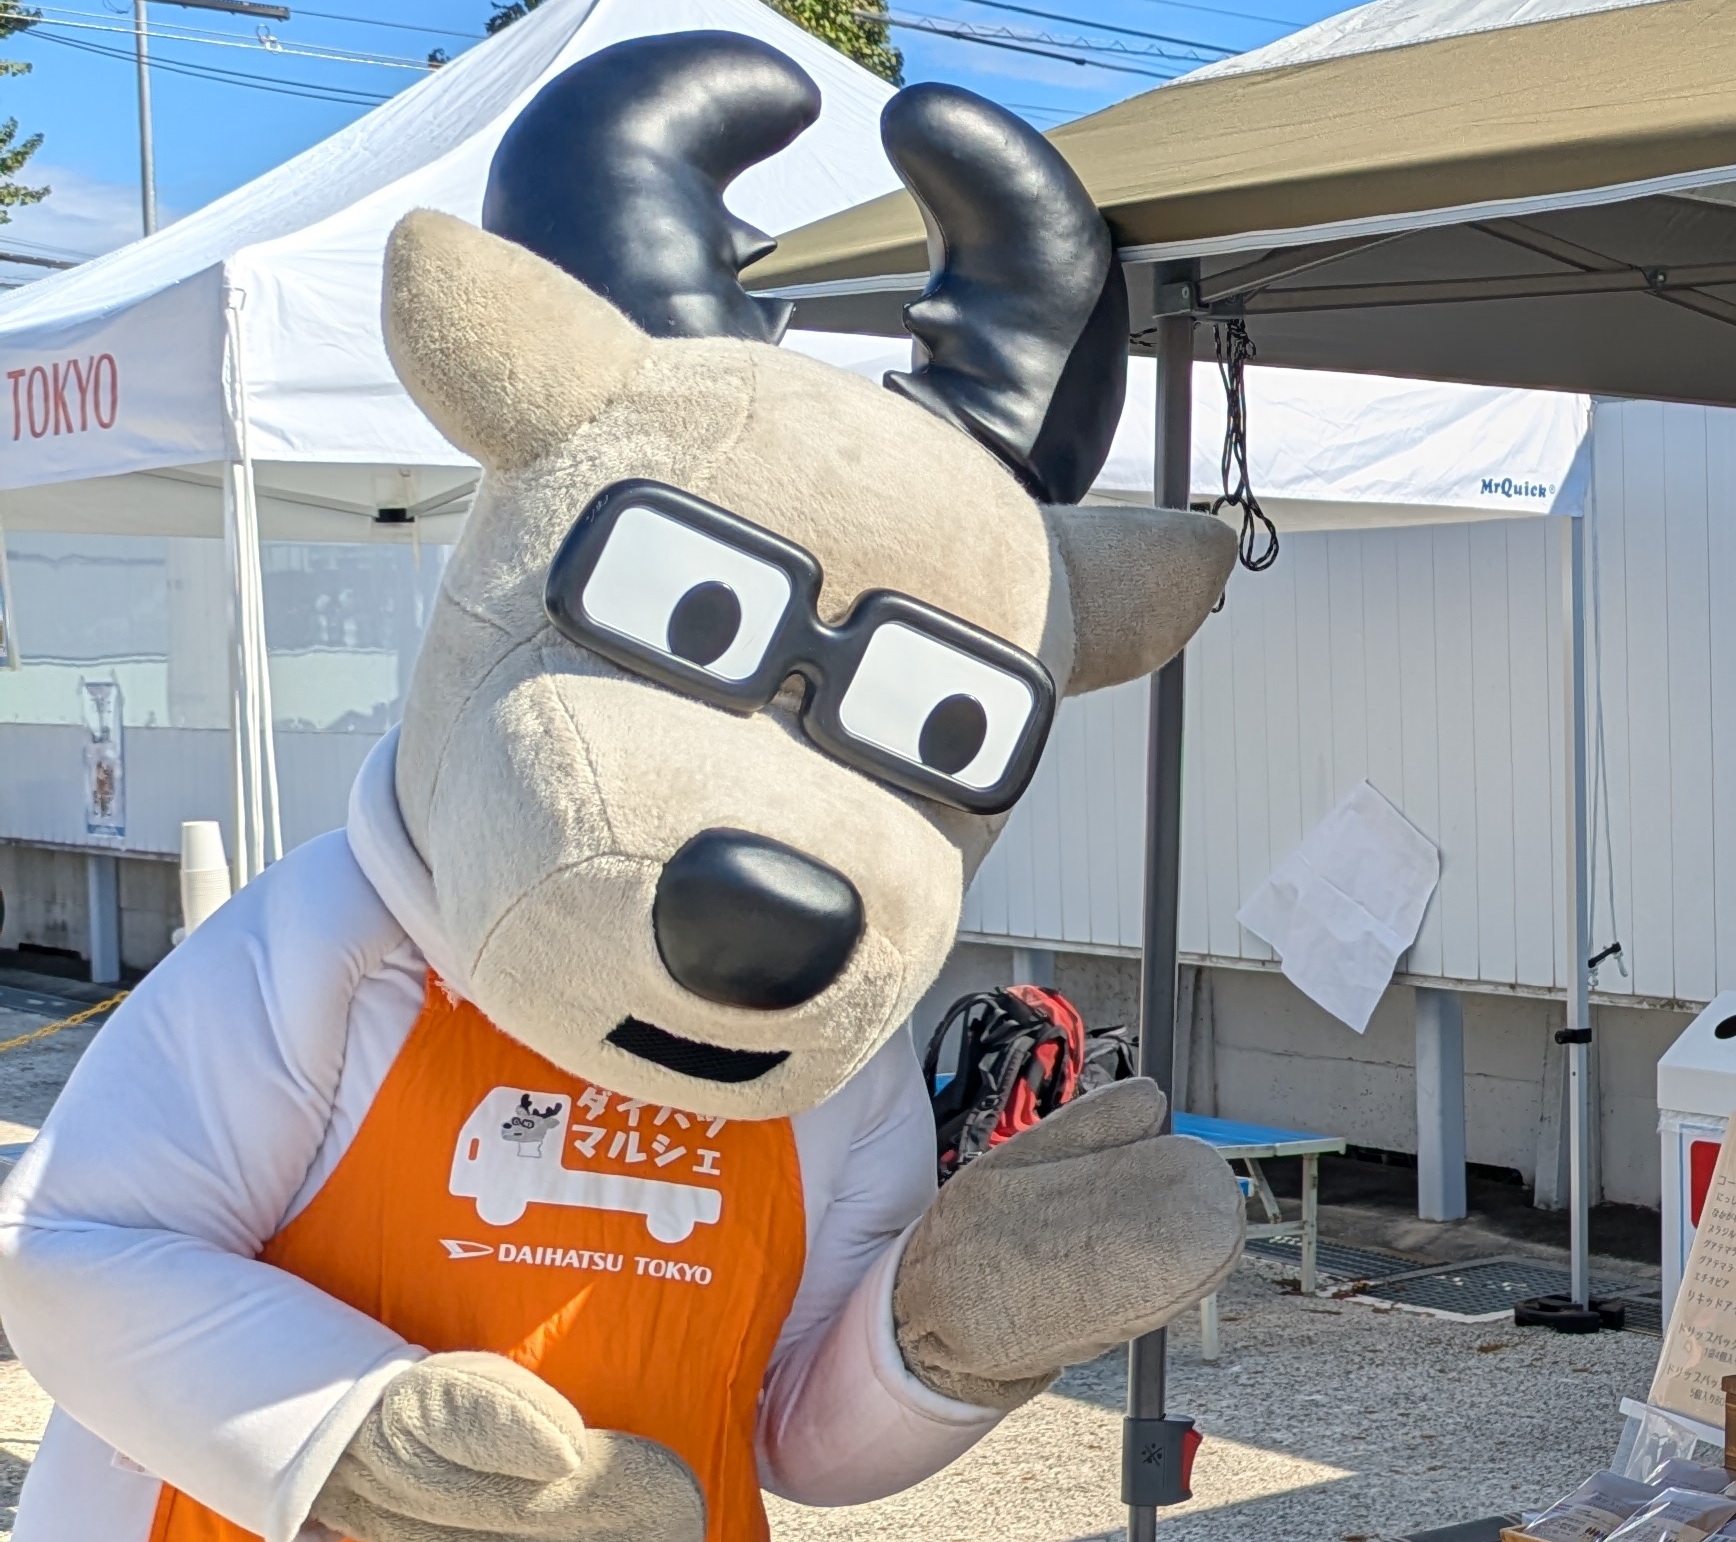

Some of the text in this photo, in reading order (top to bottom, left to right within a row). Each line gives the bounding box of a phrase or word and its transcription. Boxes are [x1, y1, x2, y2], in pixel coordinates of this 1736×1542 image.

[7, 353, 118, 441] TOKYO
[571, 1124, 721, 1176] マルシェ
[498, 1243, 713, 1285] DAIHATSU TOKYO
[1667, 1362, 1719, 1389] ドリップバッ
